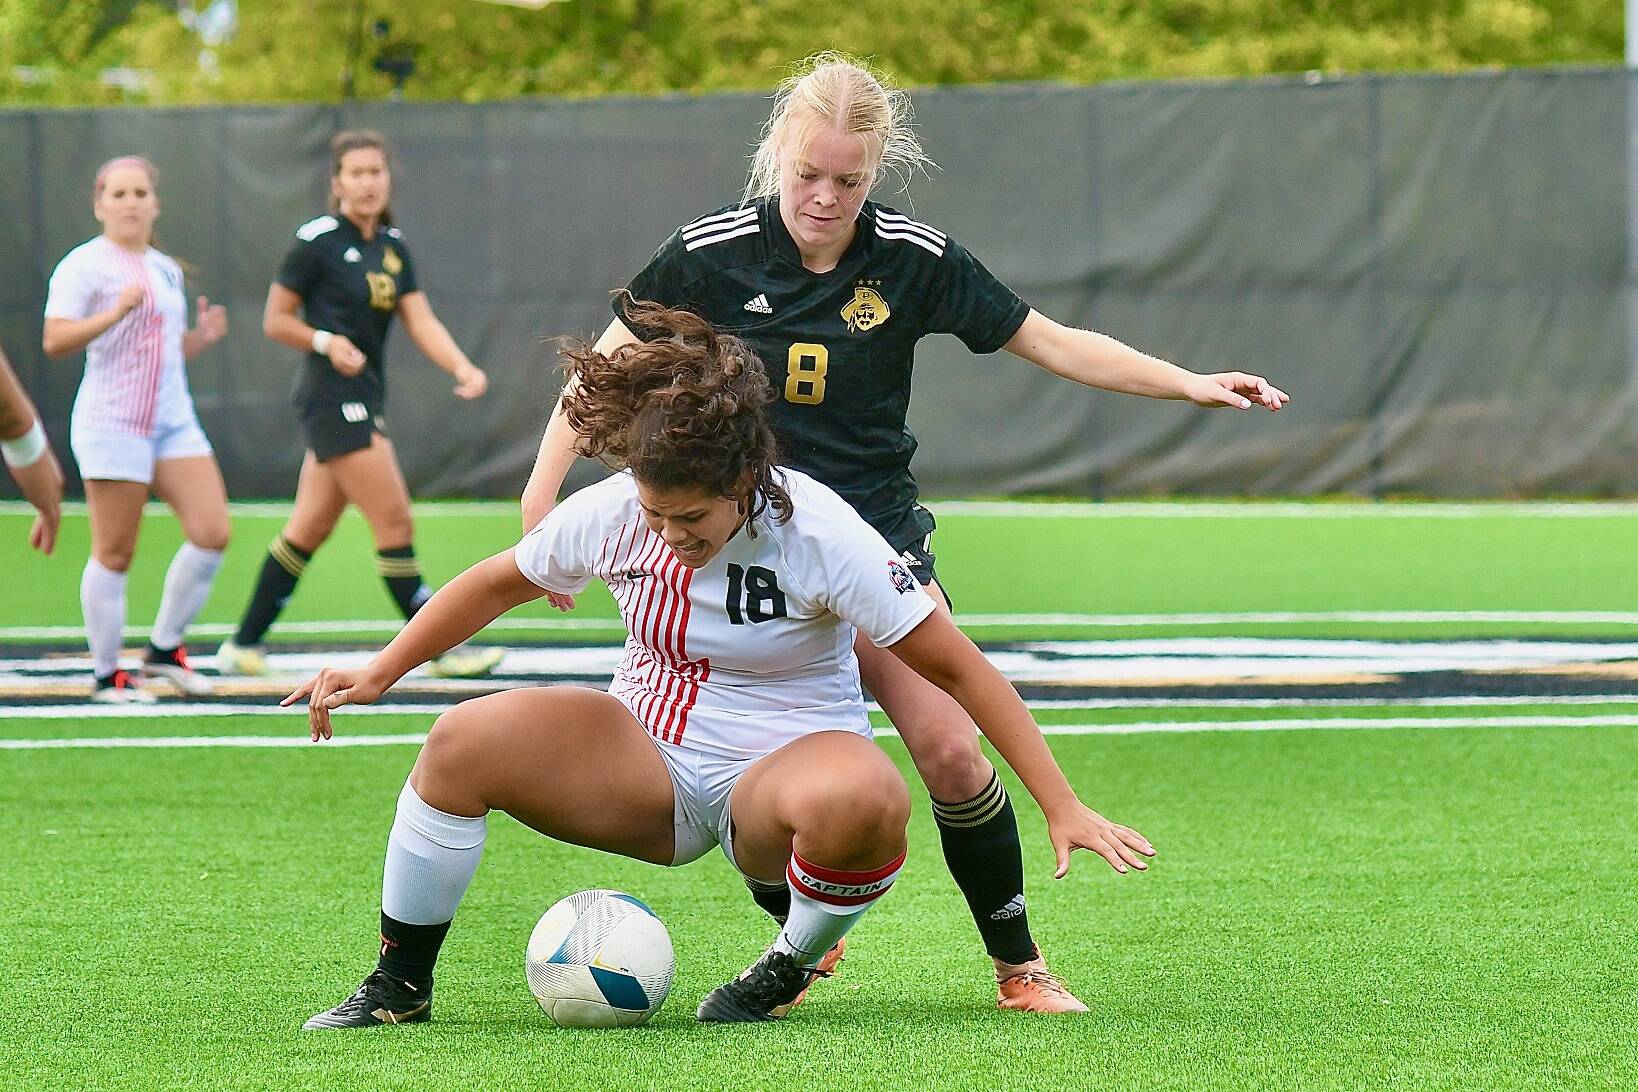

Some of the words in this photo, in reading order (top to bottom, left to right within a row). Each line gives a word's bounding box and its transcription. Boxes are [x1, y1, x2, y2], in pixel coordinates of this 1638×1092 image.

[743, 302, 773, 314] adidas
[784, 342, 829, 405] 8
[725, 562, 788, 625] 18
[800, 875, 883, 896] CAPTAIN
